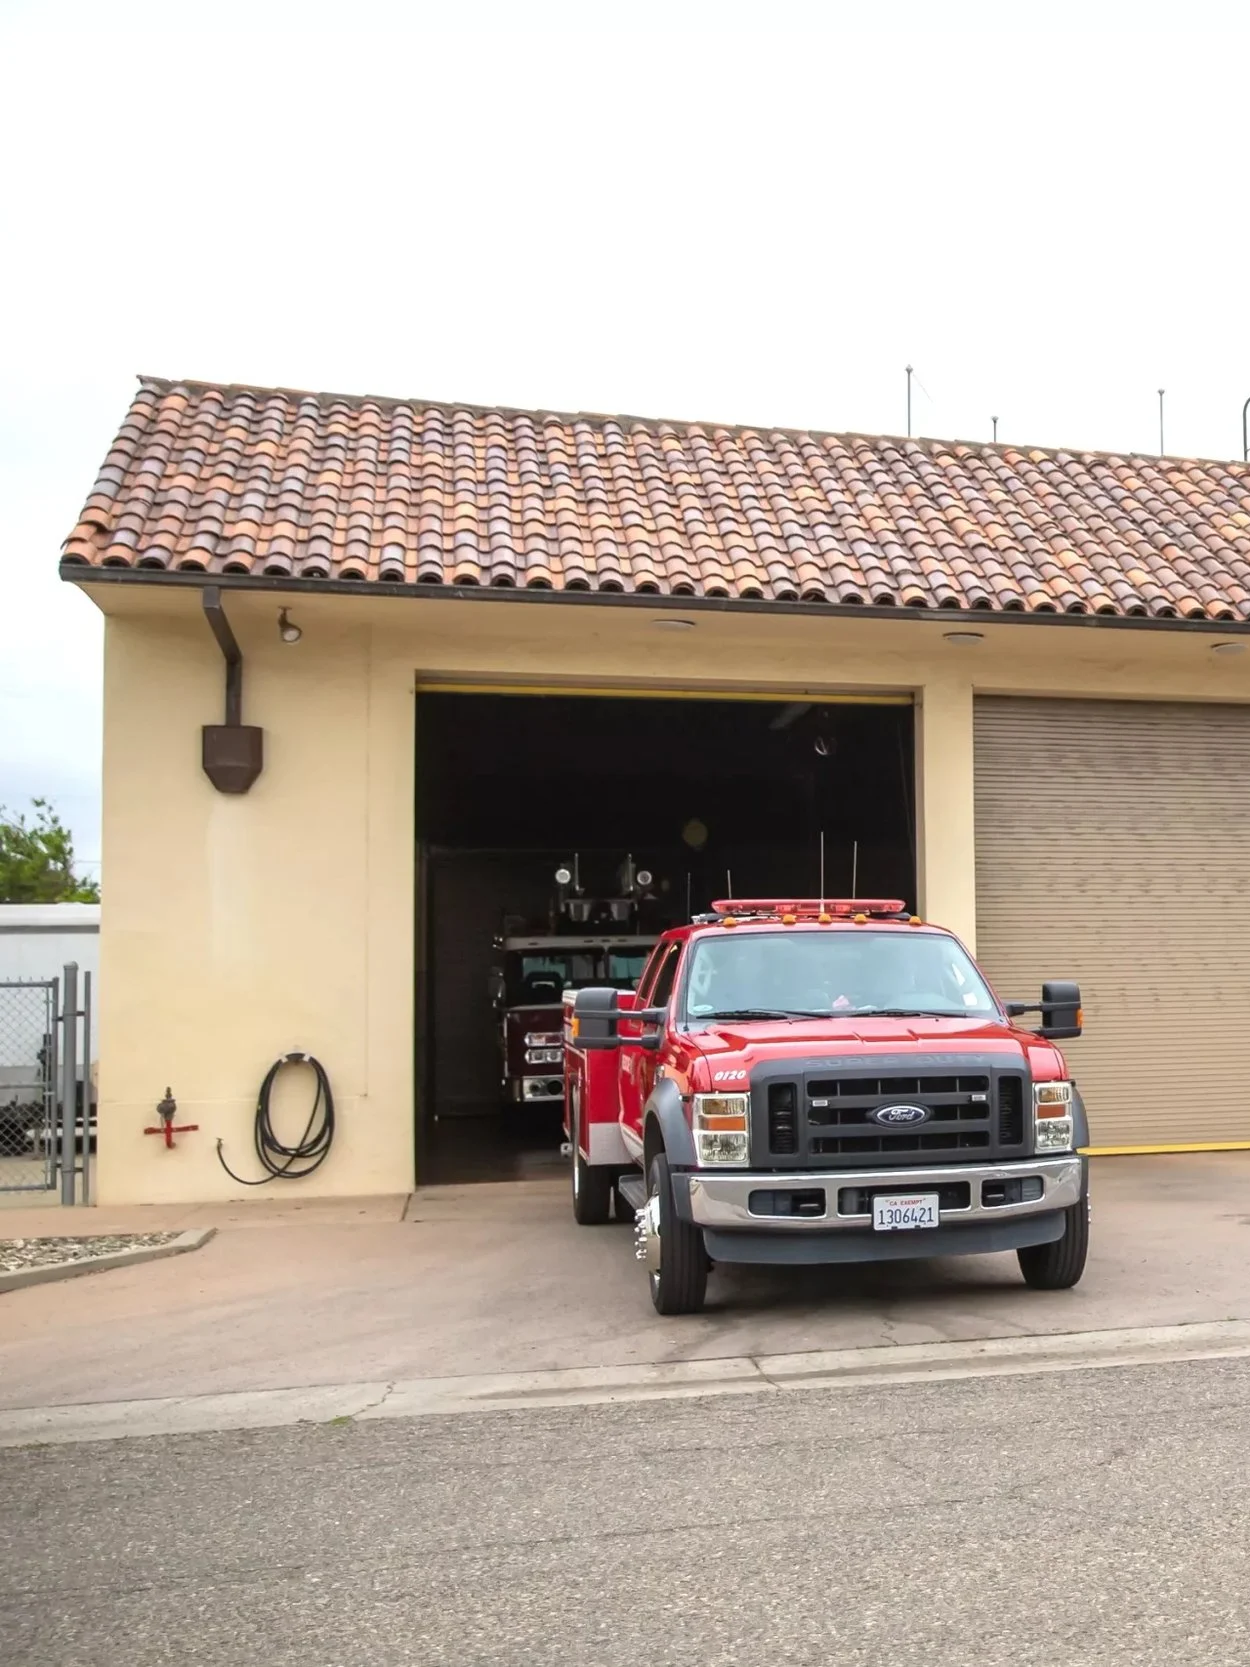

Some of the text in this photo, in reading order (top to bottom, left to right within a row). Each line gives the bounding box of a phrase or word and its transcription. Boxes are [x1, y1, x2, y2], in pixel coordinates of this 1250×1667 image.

[714, 1070, 747, 1081] 0120
[888, 1108, 914, 1122] Ford
[878, 1206, 935, 1225] 1306421
